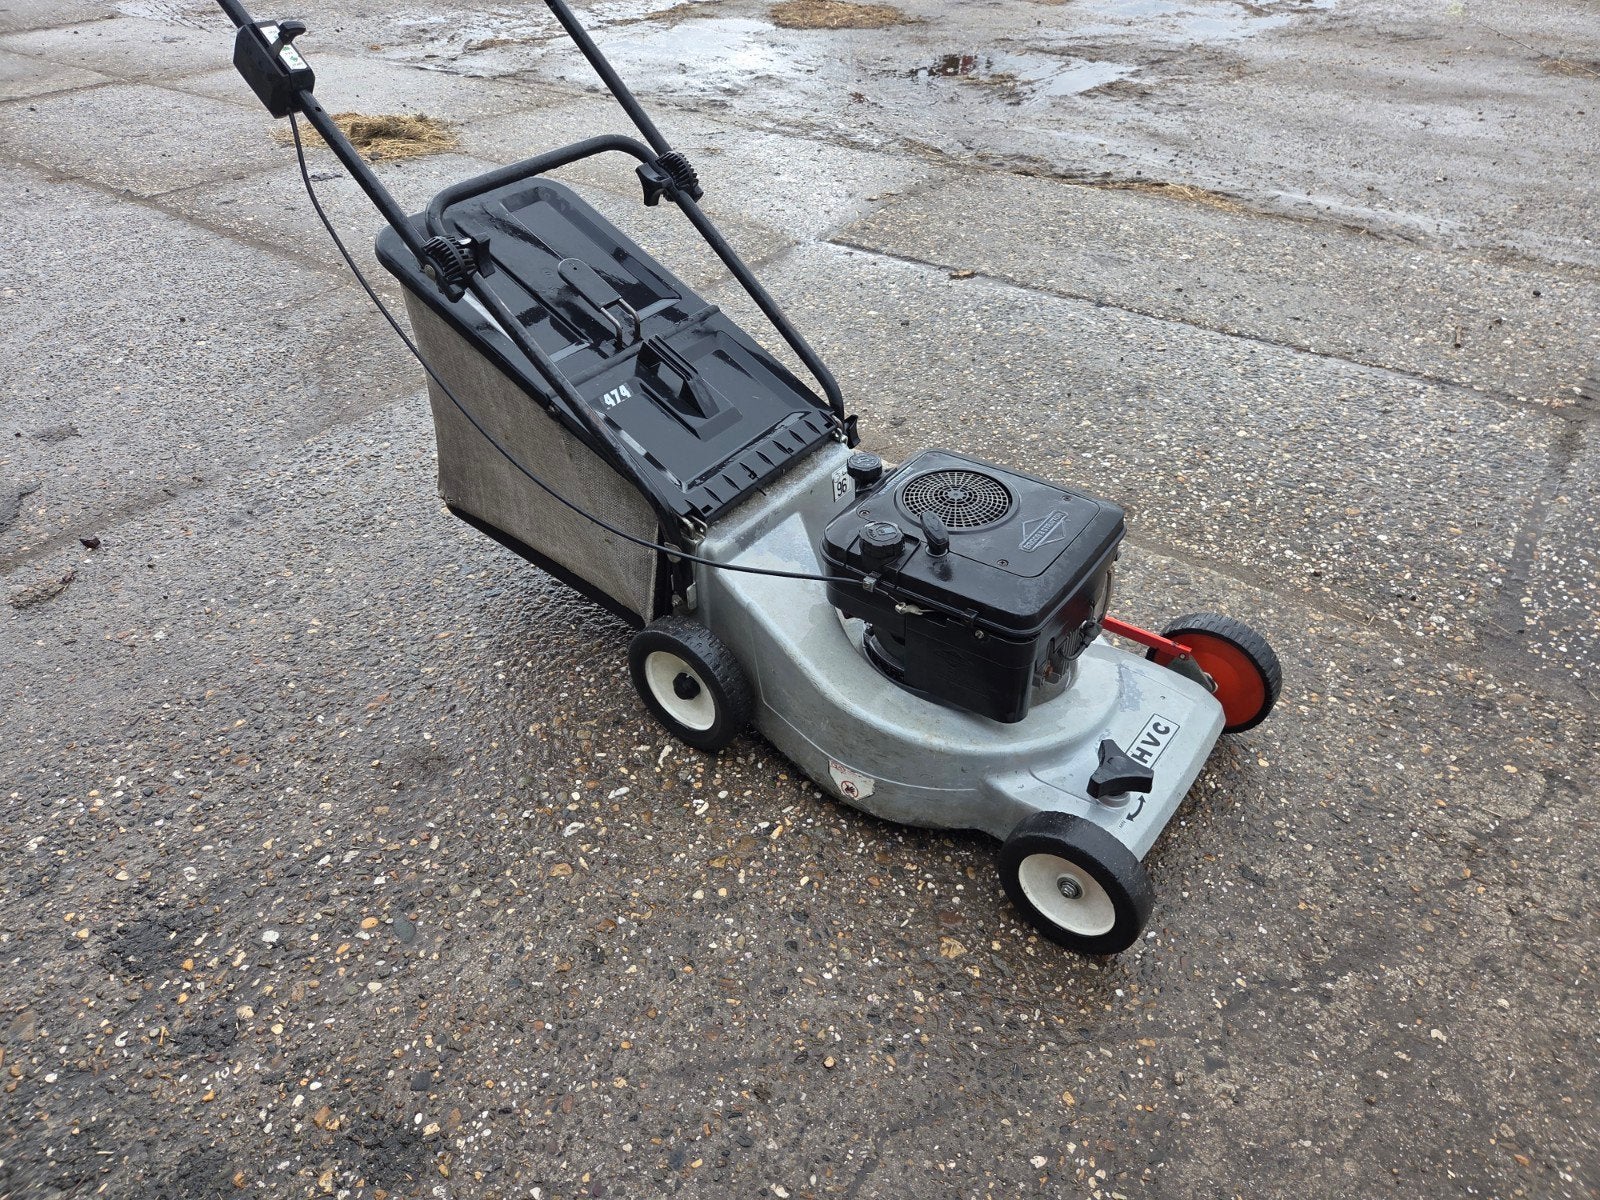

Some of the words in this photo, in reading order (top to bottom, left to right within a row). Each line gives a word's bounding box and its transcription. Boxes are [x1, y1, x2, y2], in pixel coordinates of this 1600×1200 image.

[603, 384, 631, 407] 474
[836, 477, 848, 497] 96
[1130, 721, 1171, 765] HVC
